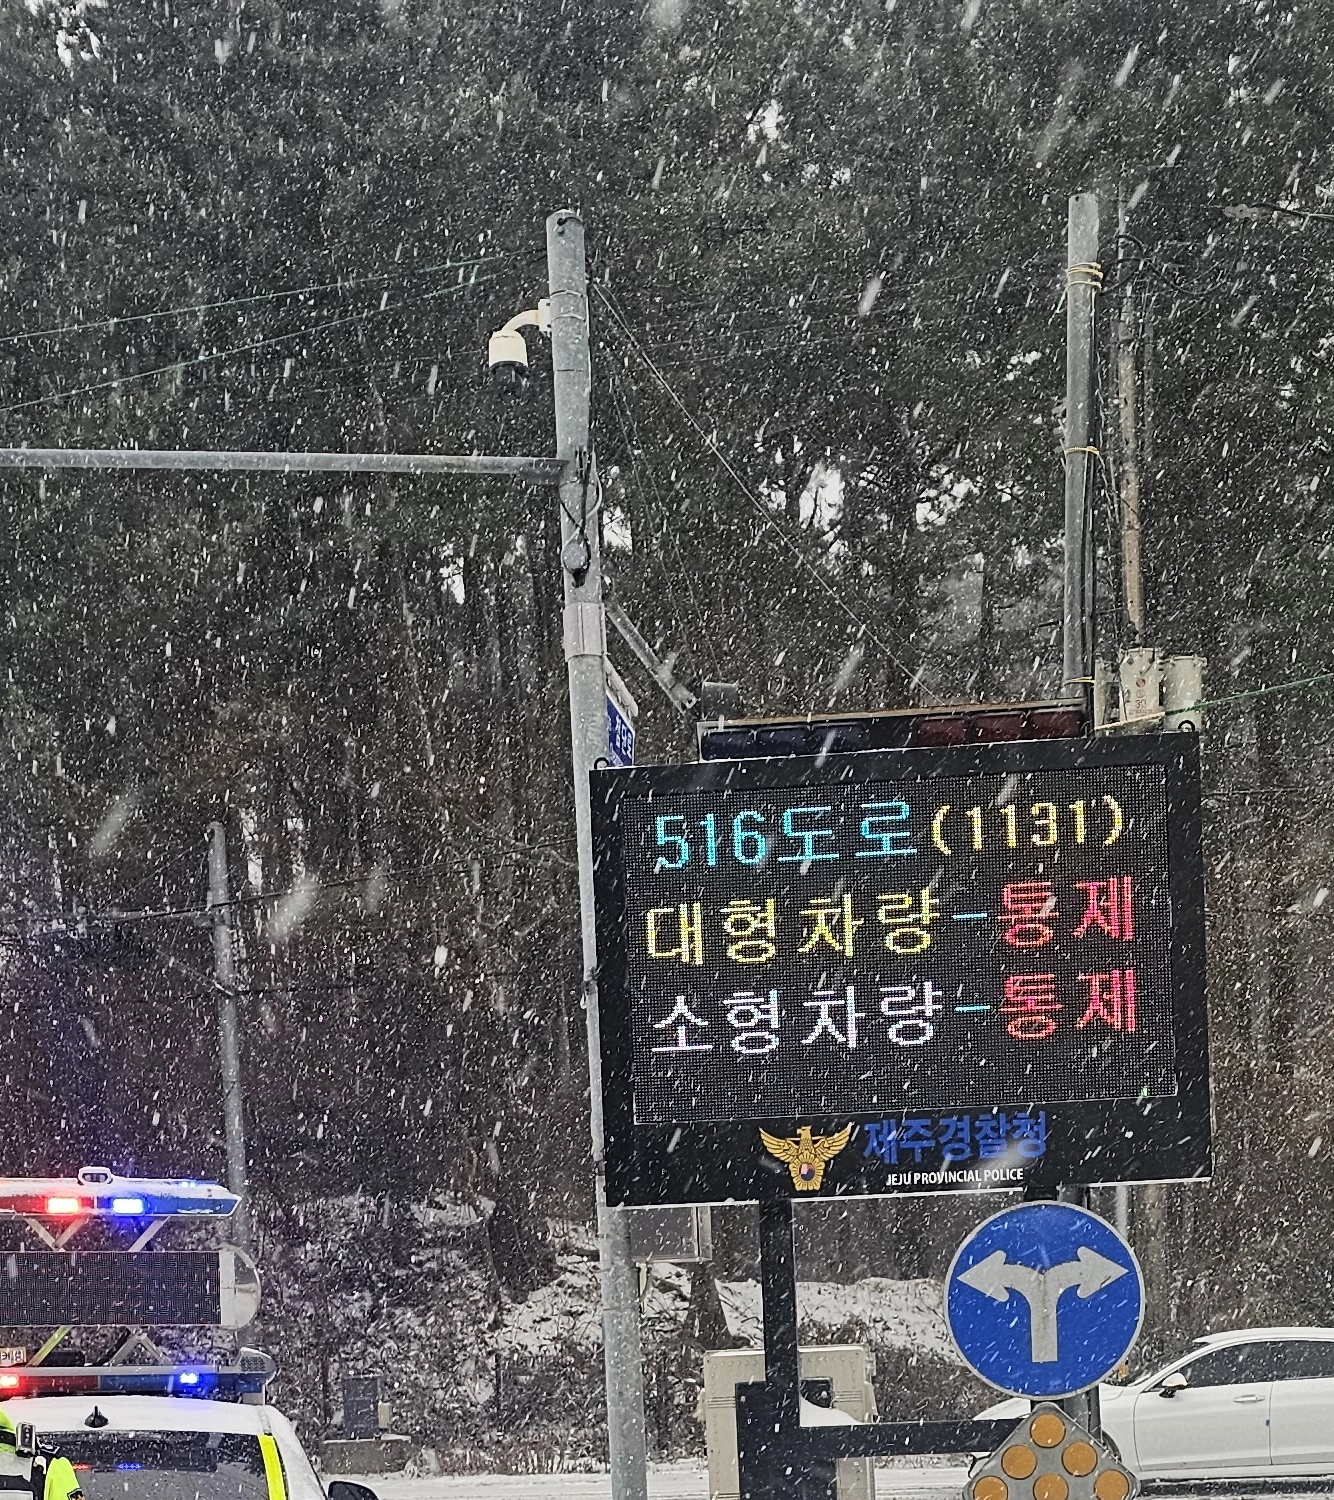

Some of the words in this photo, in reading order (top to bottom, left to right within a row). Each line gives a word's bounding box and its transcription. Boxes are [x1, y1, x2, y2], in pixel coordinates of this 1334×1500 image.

[863, 1110, 1047, 1165] 제주경찰청
[885, 1172, 912, 1187] JEJU
[913, 1169, 982, 1185] PROVINCIAL
[984, 1168, 1024, 1182] POLICE
